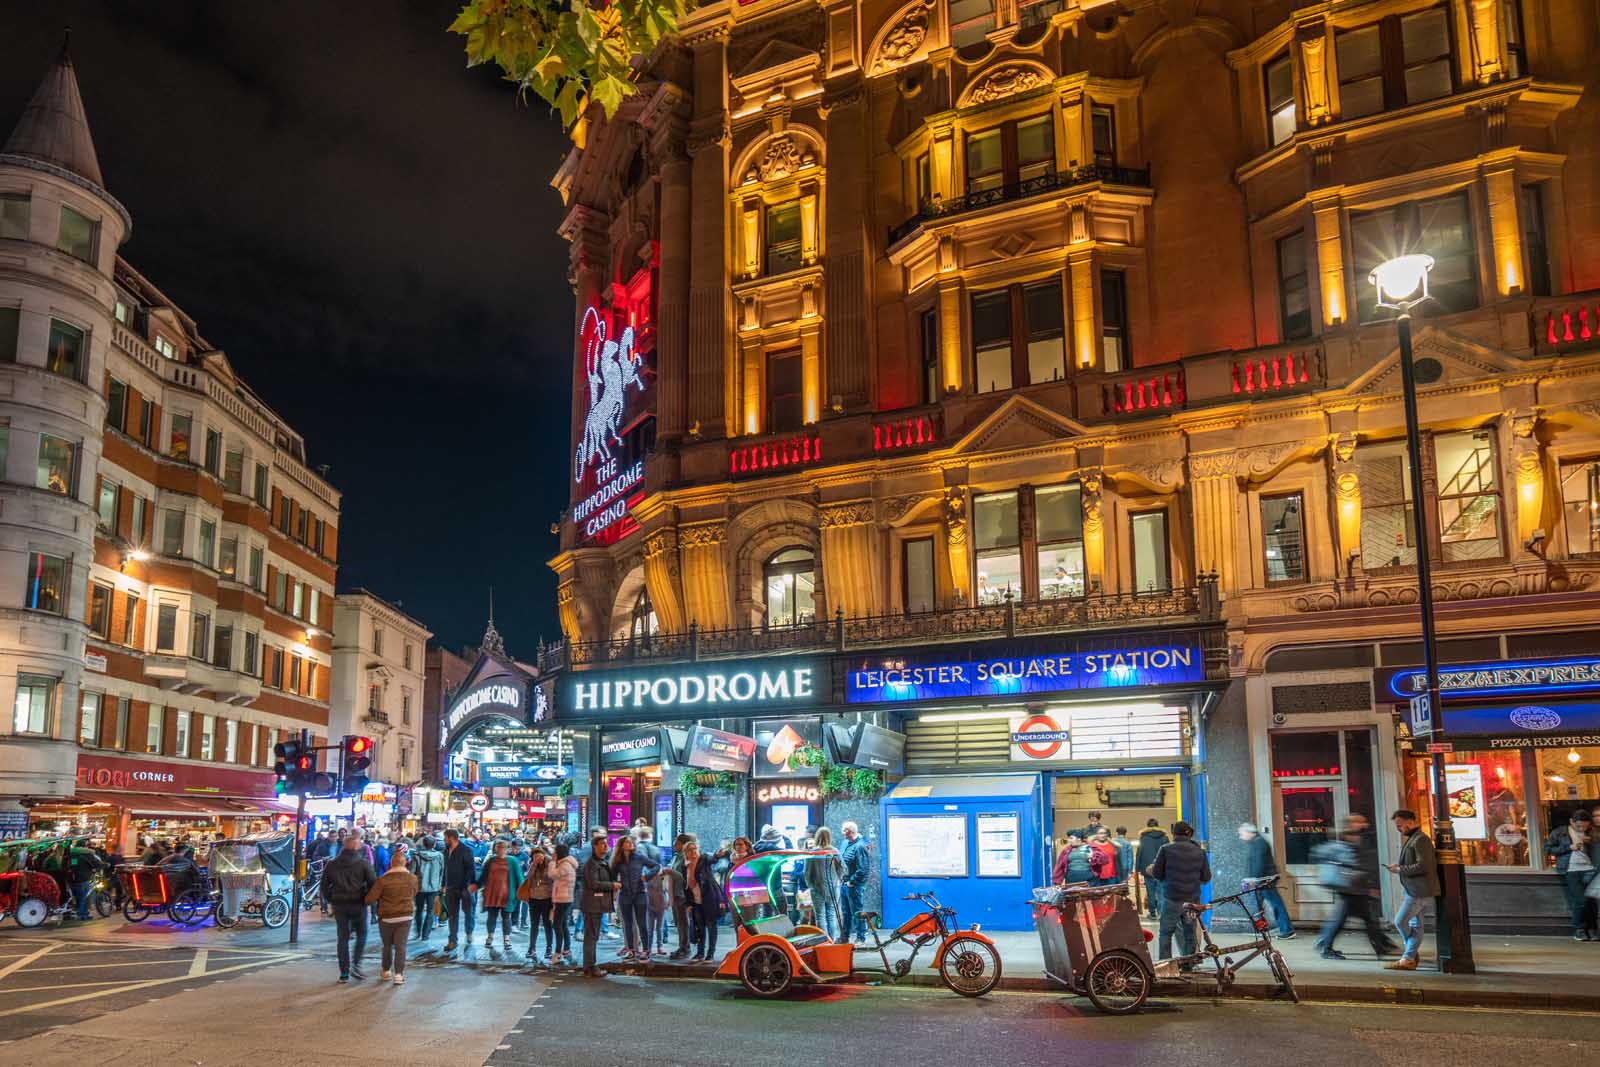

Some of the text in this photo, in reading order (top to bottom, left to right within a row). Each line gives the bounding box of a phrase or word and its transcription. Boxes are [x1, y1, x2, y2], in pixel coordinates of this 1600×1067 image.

[596, 457, 617, 485] THE
[573, 461, 643, 523] HIPPODROME
[586, 499, 626, 536] CASINO
[855, 648, 1192, 689] LEICESTER SQUARE STATION
[1411, 663, 1600, 691] PZZAEXPRES
[491, 684, 519, 708] CASINO
[575, 668, 813, 710] HIPPODROME
[602, 736, 656, 753] HIPPODROME CASINO
[1012, 731, 1068, 742] UNDERGROUND
[1491, 735, 1600, 747] PIZZA EXPRESS
[76, 767, 175, 787] FIORI CORNER
[758, 785, 819, 802] CASINO
[615, 808, 623, 818] 5
